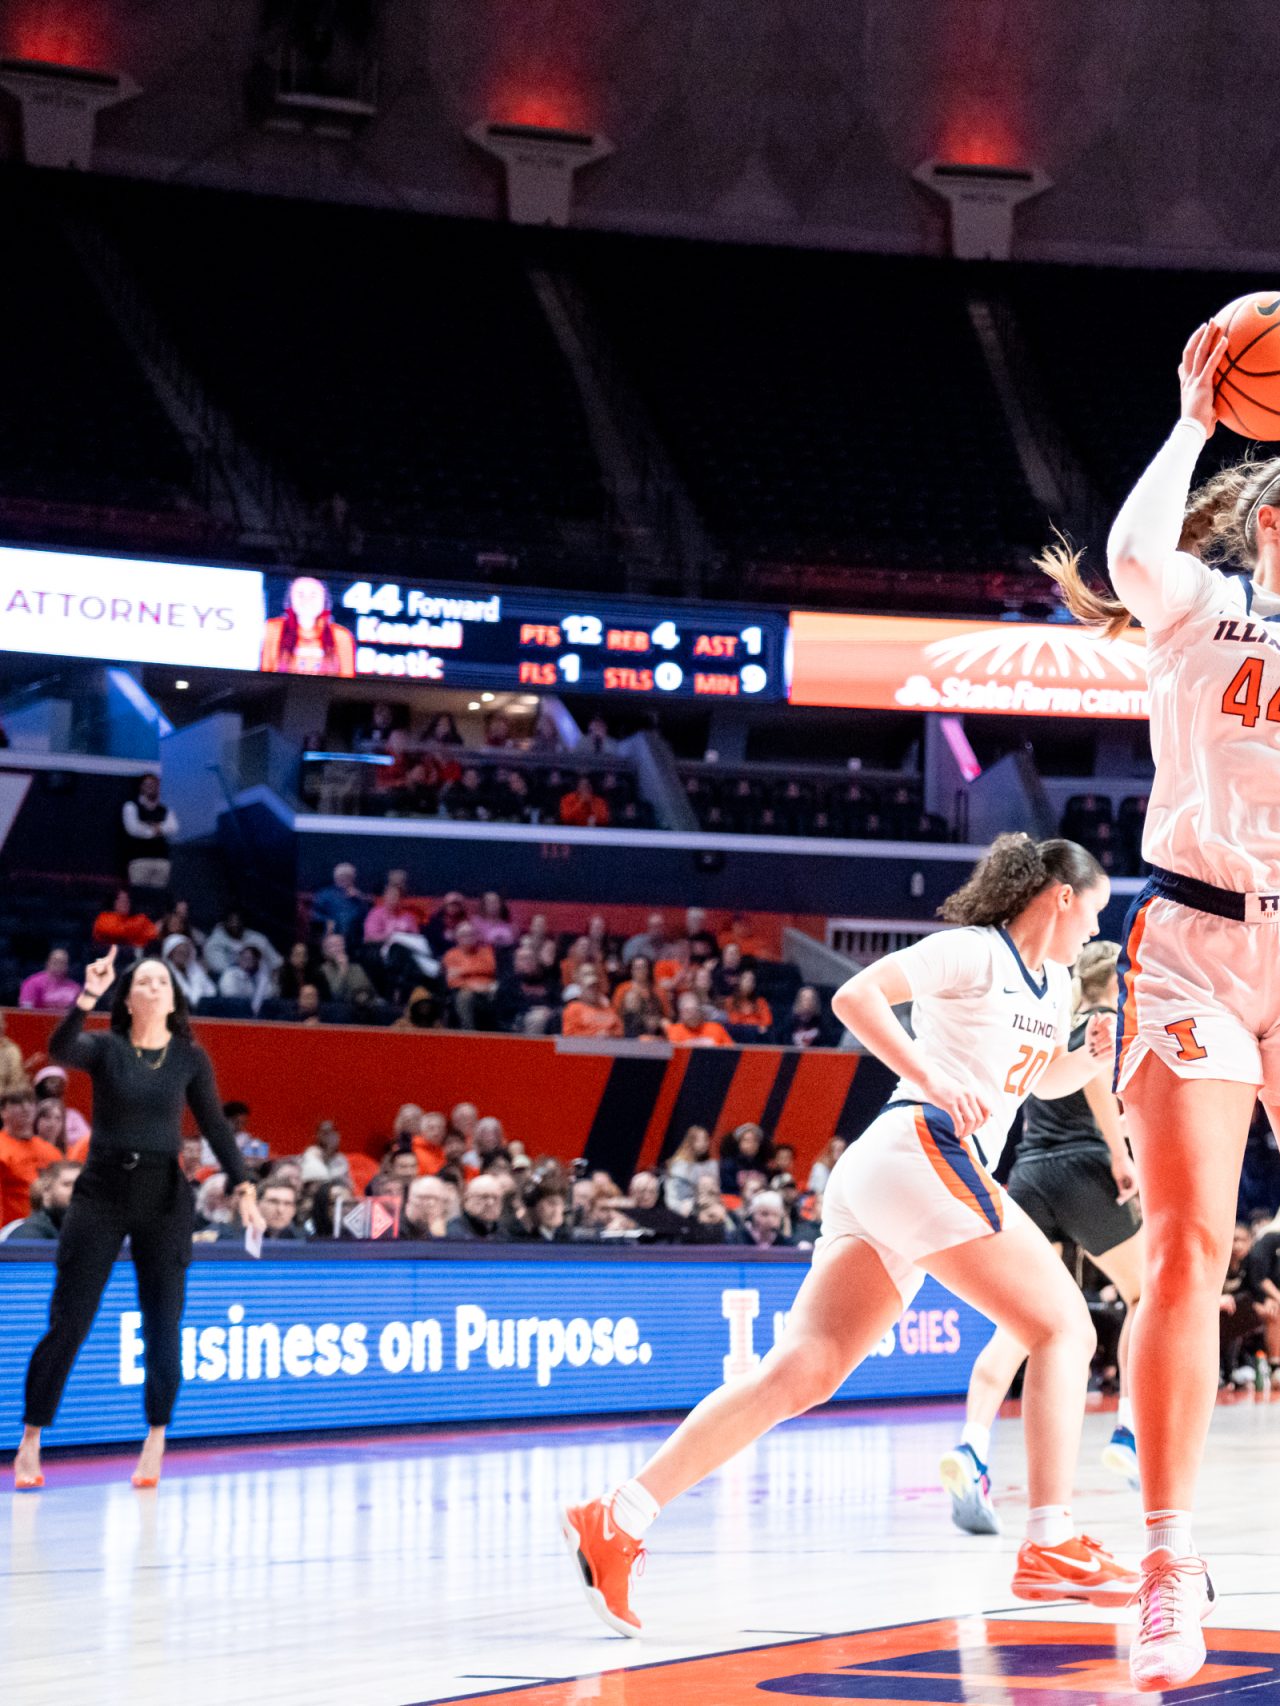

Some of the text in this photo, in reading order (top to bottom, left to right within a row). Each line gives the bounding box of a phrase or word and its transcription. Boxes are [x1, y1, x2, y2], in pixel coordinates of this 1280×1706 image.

[5, 589, 236, 631] ATTORNEYS
[343, 582, 501, 623] 44 Forward
[357, 615, 463, 649] Kendall
[519, 615, 762, 657] PTS 12 REB 4 AST 1
[519, 653, 768, 695] FLS 1 STLS 0 MIN 9
[1165, 1017, 1208, 1062] I
[1003, 1044, 1049, 1097] 20
[379, 1318, 442, 1373] on
[456, 1304, 653, 1387] Purpose.
[900, 1309, 961, 1355] GIES
